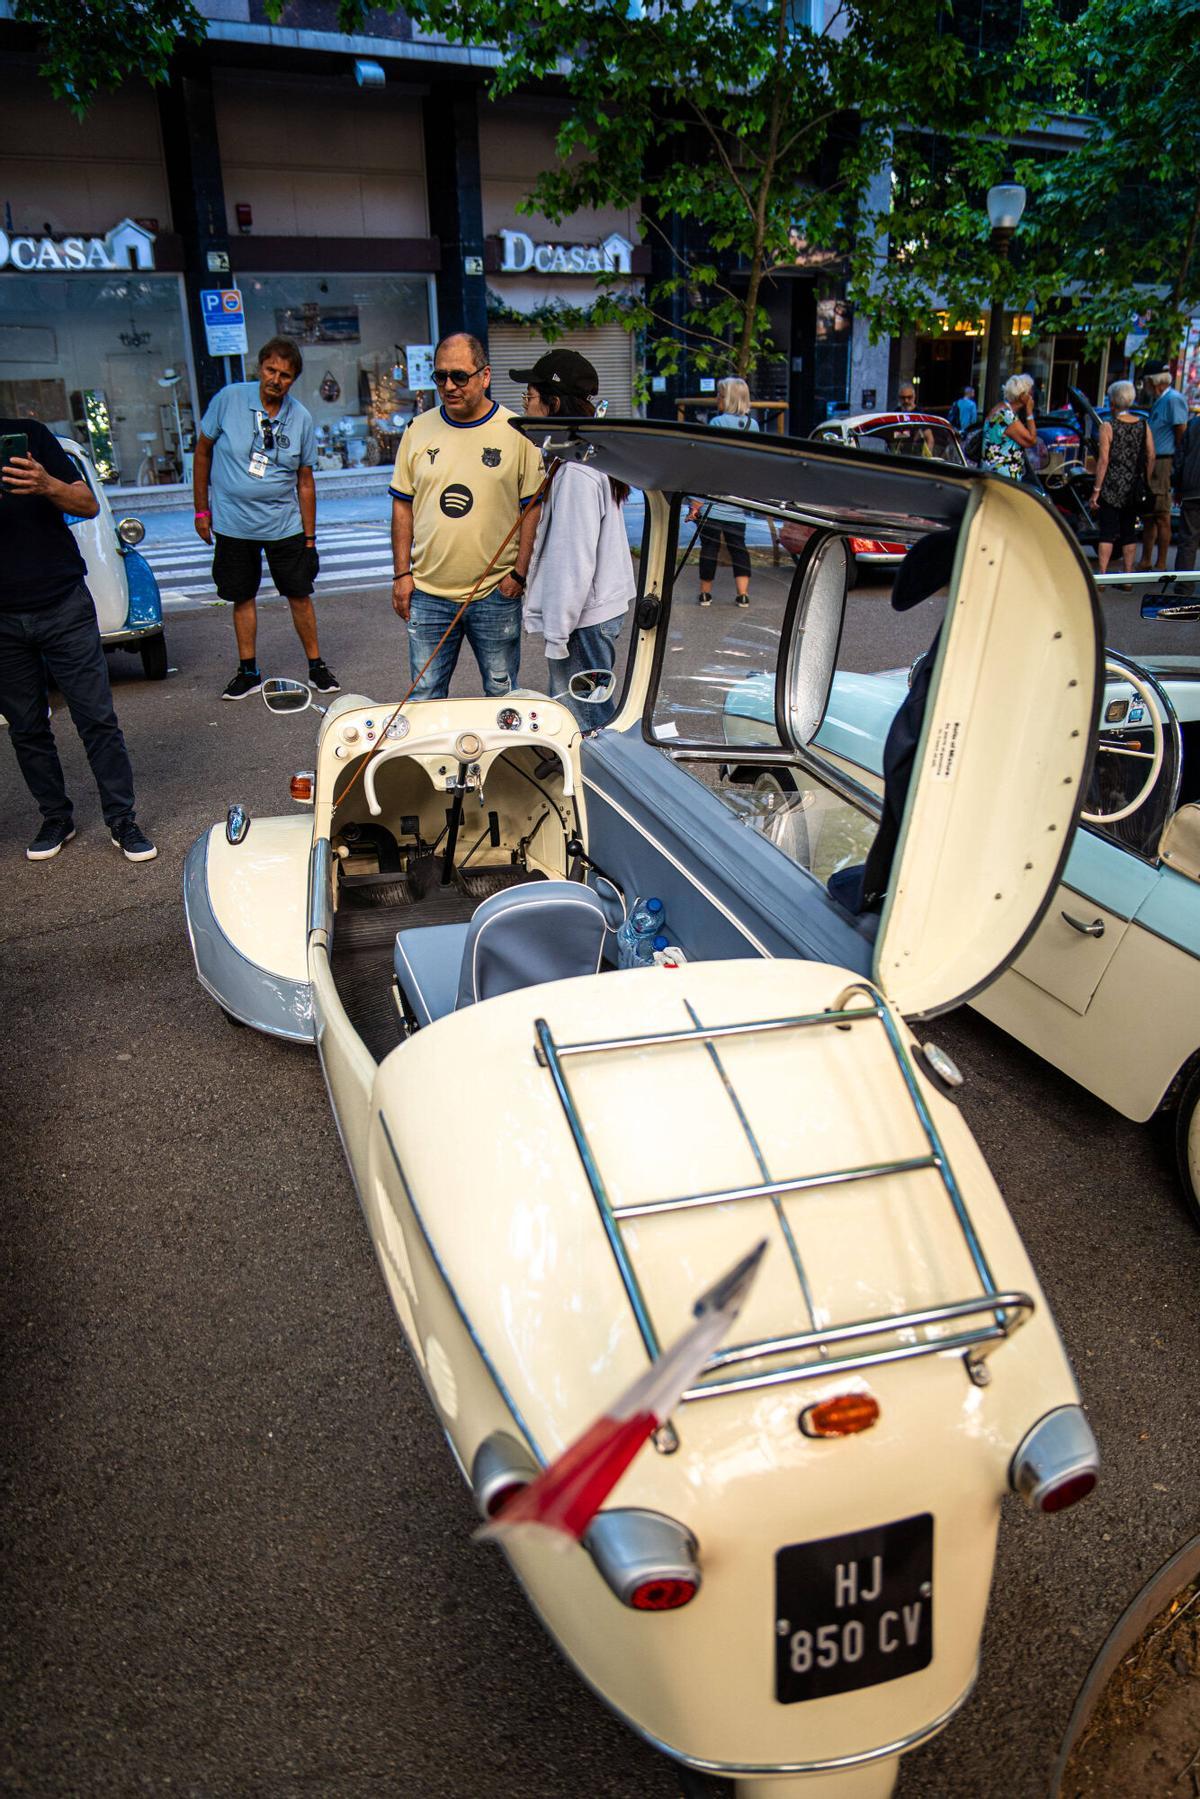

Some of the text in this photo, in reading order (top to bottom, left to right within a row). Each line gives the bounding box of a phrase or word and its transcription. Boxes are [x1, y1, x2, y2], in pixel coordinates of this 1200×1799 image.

[500, 229, 604, 273] DCASA
[206, 294, 220, 311] P
[835, 1555, 882, 1608] HJ
[790, 1601, 922, 1673] 850 CV
